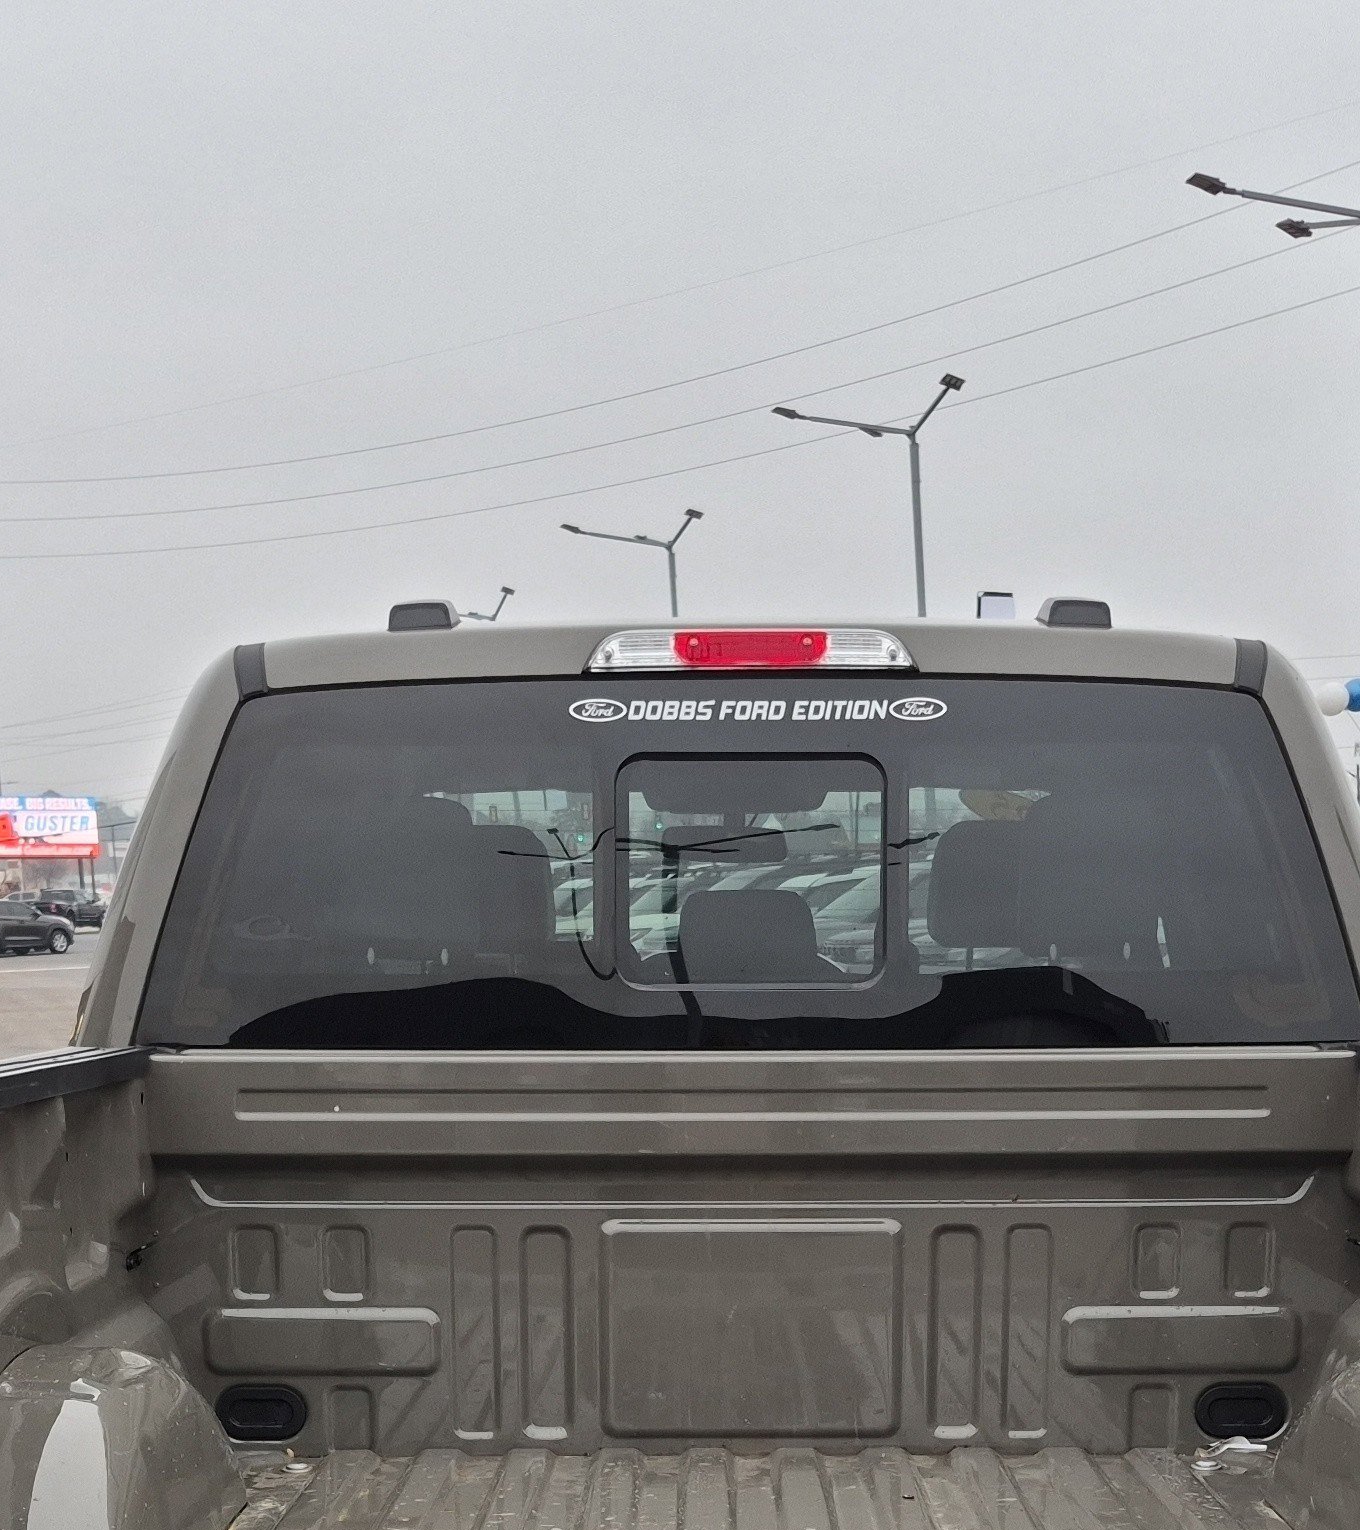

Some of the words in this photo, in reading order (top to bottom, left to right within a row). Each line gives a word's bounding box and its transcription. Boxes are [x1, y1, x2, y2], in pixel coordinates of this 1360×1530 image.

[628, 699, 716, 721] DOBBS
[719, 700, 787, 721] FORD
[792, 699, 889, 721] EDITION
[24, 815, 90, 832] GUSTER
